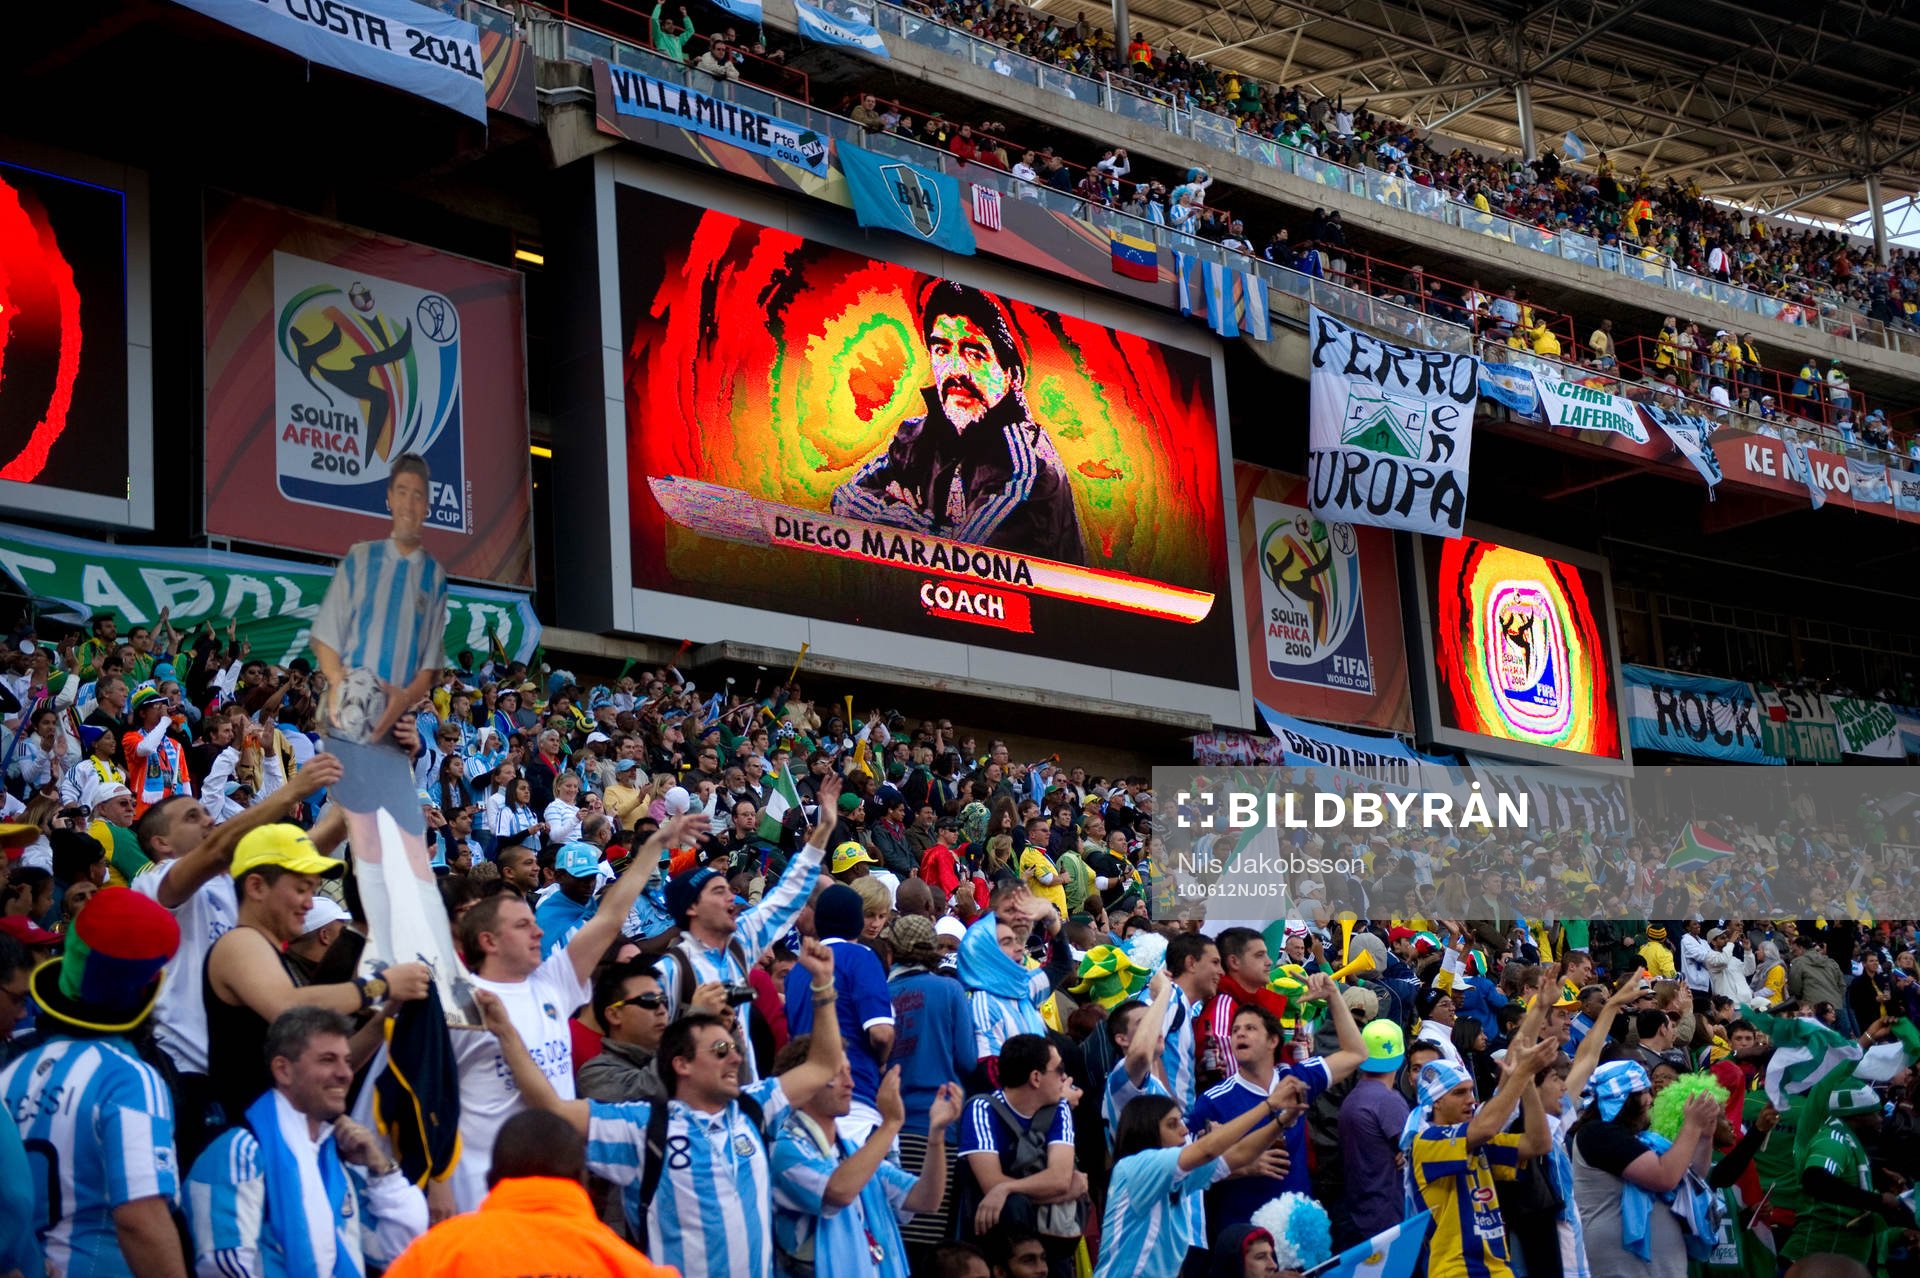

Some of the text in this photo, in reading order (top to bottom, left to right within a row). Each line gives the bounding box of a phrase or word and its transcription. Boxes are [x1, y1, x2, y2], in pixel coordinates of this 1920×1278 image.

[405, 28, 483, 81] 2011
[613, 69, 772, 147] VILLA MITRE
[801, 140, 825, 158] CVM
[1312, 315, 1479, 405] FERRO
[1557, 382, 1613, 406] CHIRI
[290, 404, 360, 435] SOUTH
[1559, 404, 1644, 443] LAFERRER
[282, 423, 360, 457] AFRICA
[310, 451, 361, 477] 2010
[1744, 443, 1776, 477] KE
[1782, 453, 1851, 494] NKO
[435, 509, 461, 524] CUP
[774, 517, 1034, 587] DIEGO MARADONA
[920, 583, 1005, 620] COACH
[1268, 623, 1311, 643] AFRICA
[1271, 608, 1309, 628] SOUTH
[1285, 642, 1312, 658] 2010
[1326, 673, 1369, 689] WORLD CUP
[1332, 655, 1368, 678] FIFA
[1651, 683, 1762, 750] ROCK
[668, 1134, 692, 1170] 8
